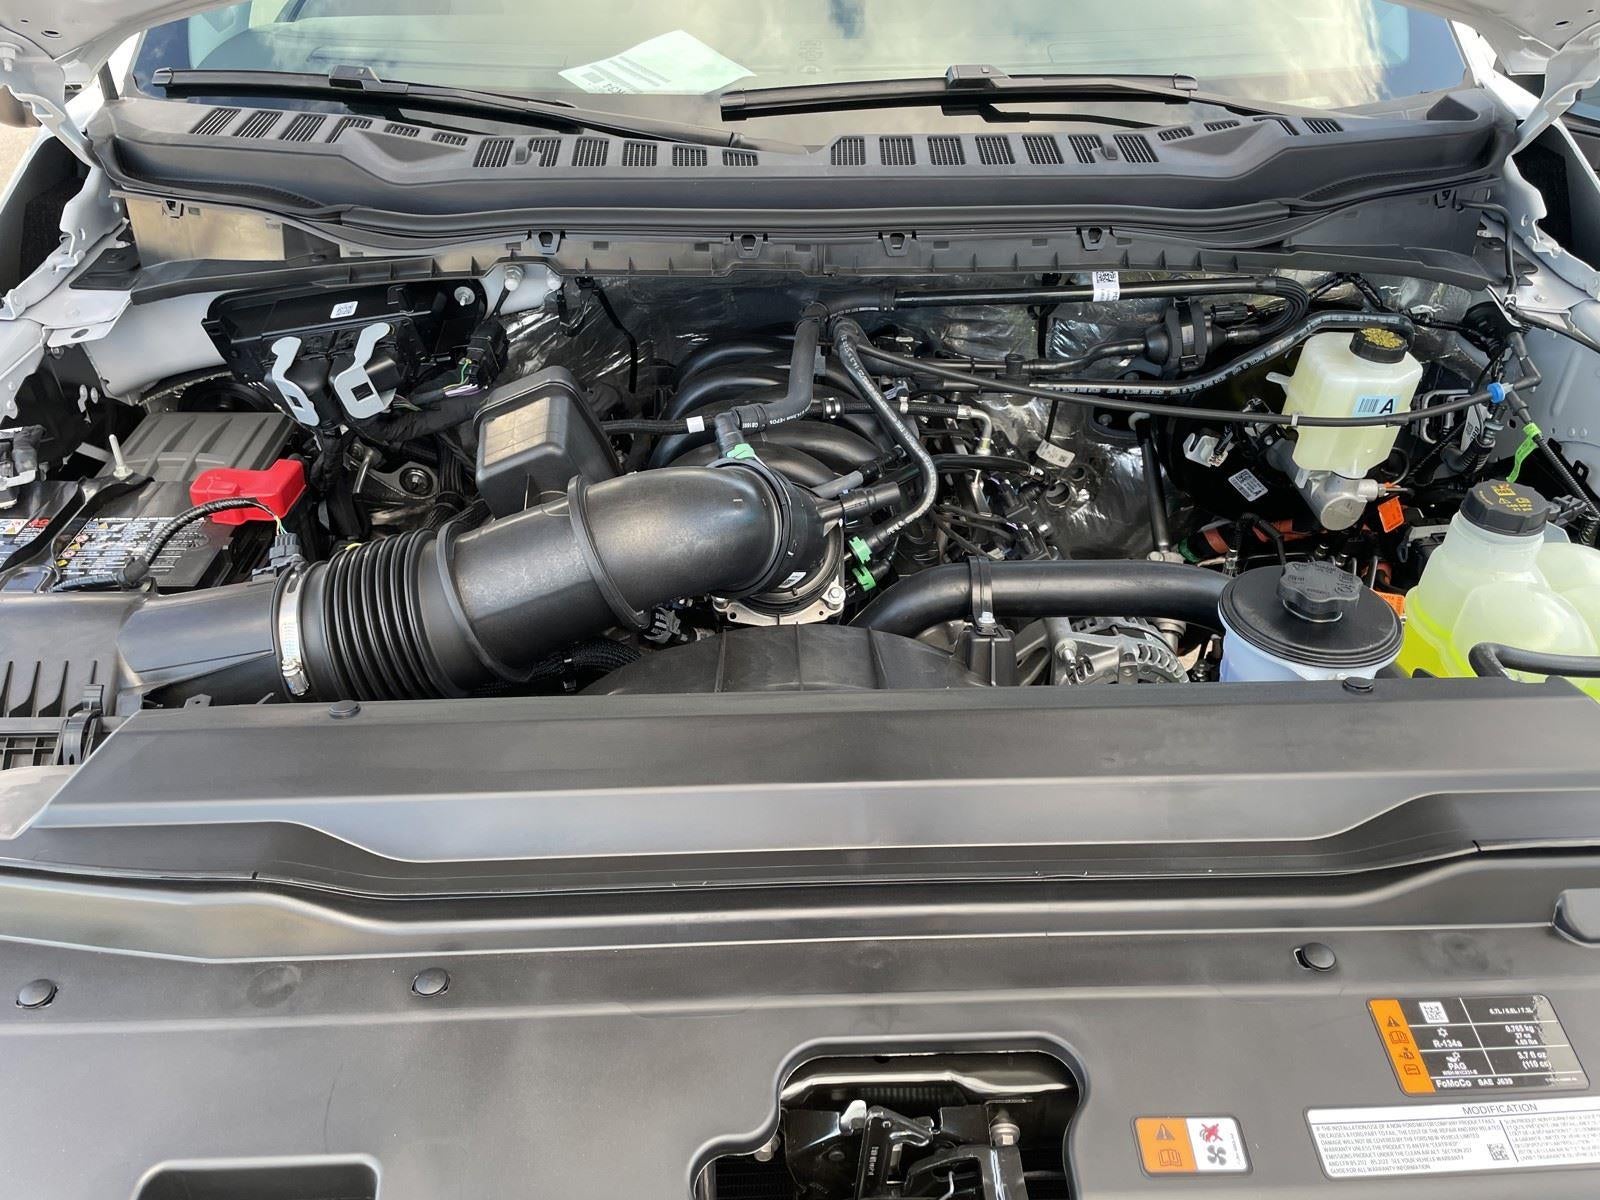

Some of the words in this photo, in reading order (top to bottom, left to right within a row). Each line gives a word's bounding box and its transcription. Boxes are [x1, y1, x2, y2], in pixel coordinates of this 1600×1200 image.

[1379, 398, 1394, 414] A
[1524, 1025, 1535, 1033] kg
[1432, 1039, 1463, 1048] R-134a
[1435, 1079, 1472, 1088] FoMoCo
[1477, 1078, 1494, 1086] SAE
[1462, 1103, 1538, 1115] MODIFICATION
